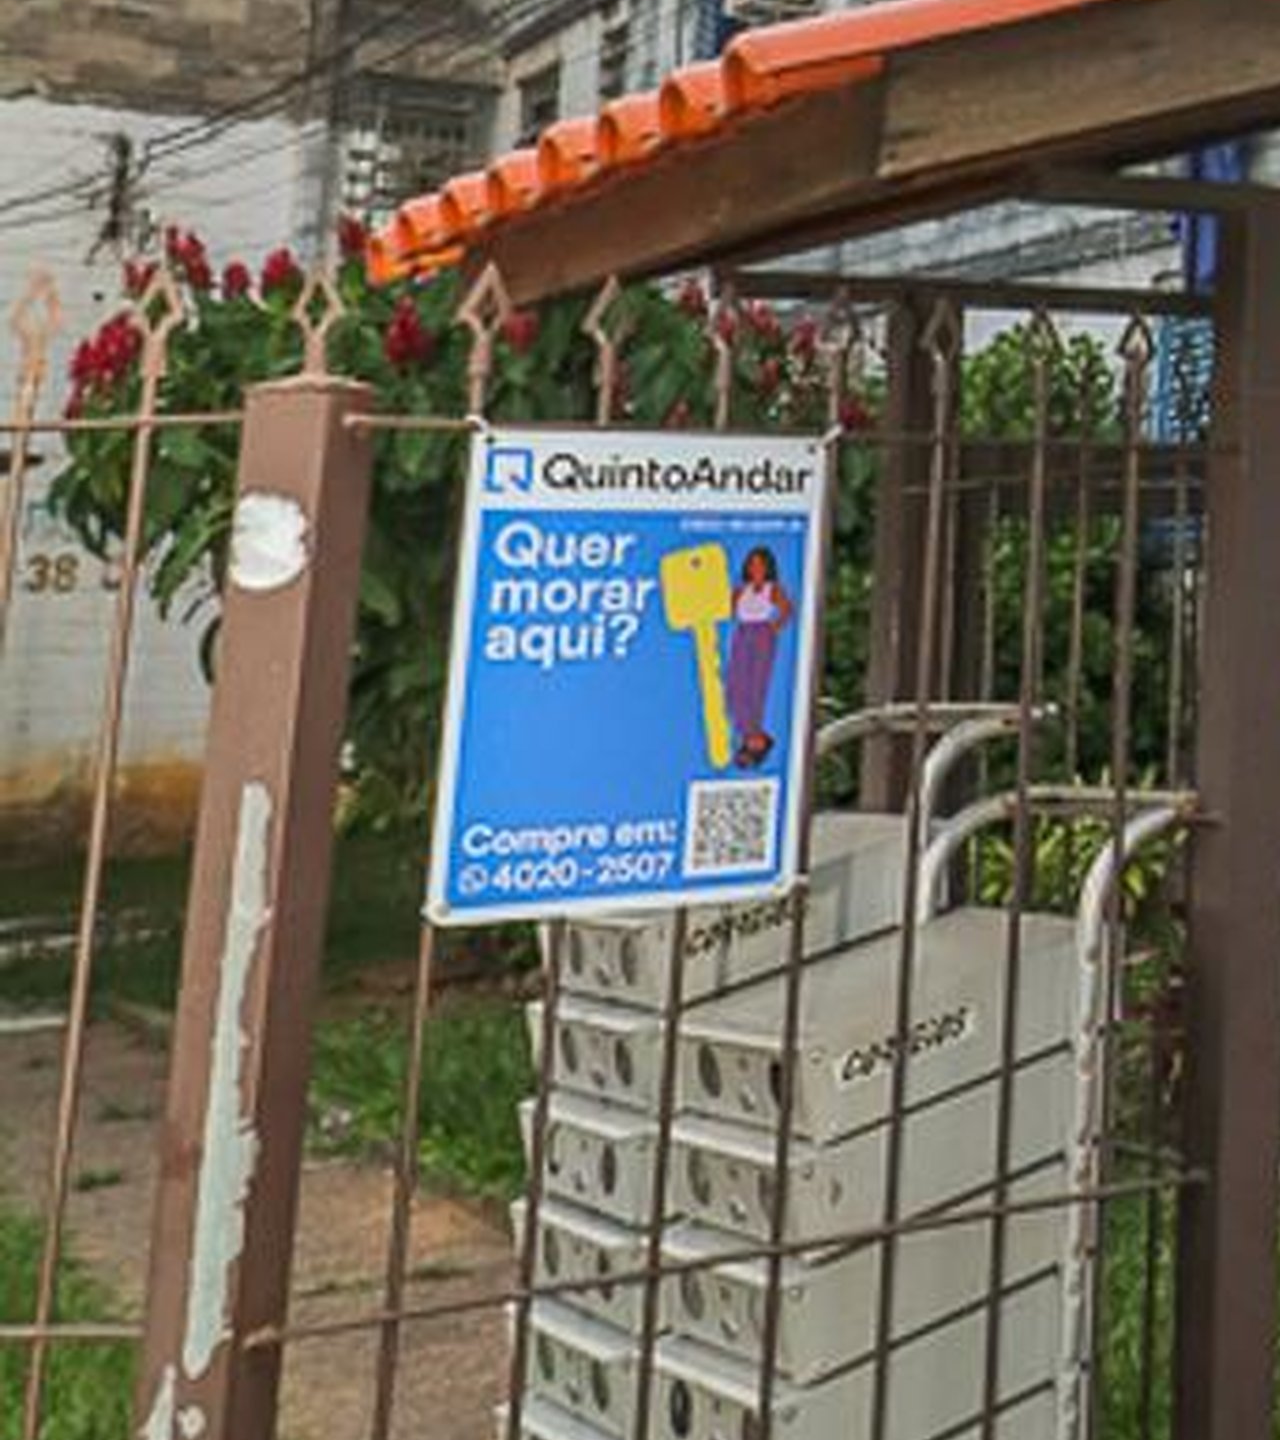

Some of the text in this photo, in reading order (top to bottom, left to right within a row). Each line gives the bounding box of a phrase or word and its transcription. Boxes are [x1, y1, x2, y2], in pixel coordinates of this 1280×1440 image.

[540, 452, 812, 494] QuintoAndar
[495, 520, 635, 568] Quer
[489, 576, 656, 613] morar
[484, 613, 640, 668] aqui?
[462, 820, 678, 857] Compre em:
